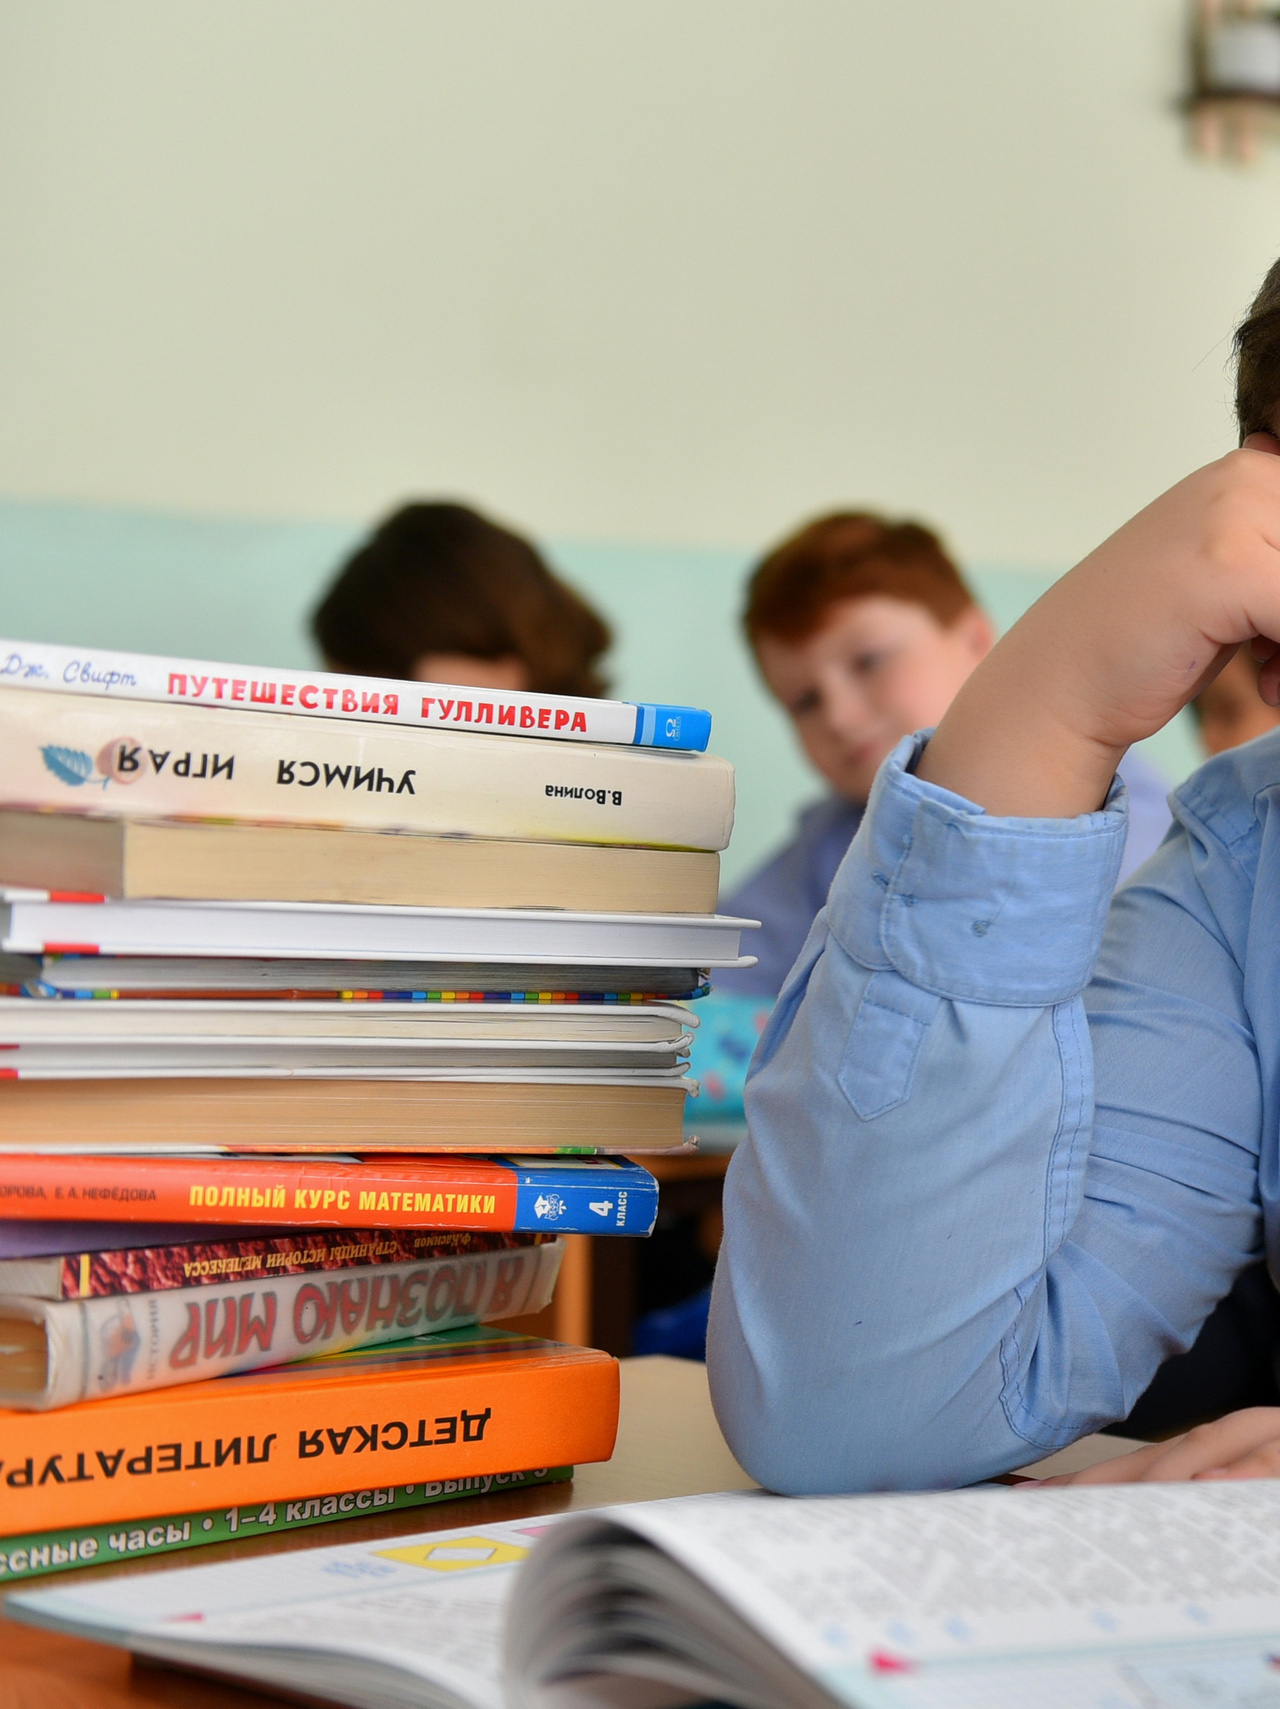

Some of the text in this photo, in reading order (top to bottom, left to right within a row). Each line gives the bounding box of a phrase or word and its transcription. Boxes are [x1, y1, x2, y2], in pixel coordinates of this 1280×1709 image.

[62, 660, 137, 691] Свифт
[167, 672, 587, 733] ПУТЕШЕСТВИЯ ГУЛЛИВЕРА
[117, 744, 417, 795] УЧИМСЯ ИГРАЯ
[545, 785, 623, 806] В.Волина
[189, 1185, 496, 1214] ПОЛНЫЙ КУРС МАТЕМАТИКИ
[589, 1191, 628, 1227] 4 КЛАСС
[183, 1240, 398, 1278] СТРАНИЦЫ ИСТОРИИ МЕЛЕКЕССА
[292, 1258, 488, 1345] ПОЗНАЮ
[168, 1291, 278, 1370] МИР
[0, 1407, 492, 1489] ДЕТСКАЯ ЛИТЕРАТУР
[108, 1521, 191, 1553] часы
[285, 1486, 395, 1522] классы
